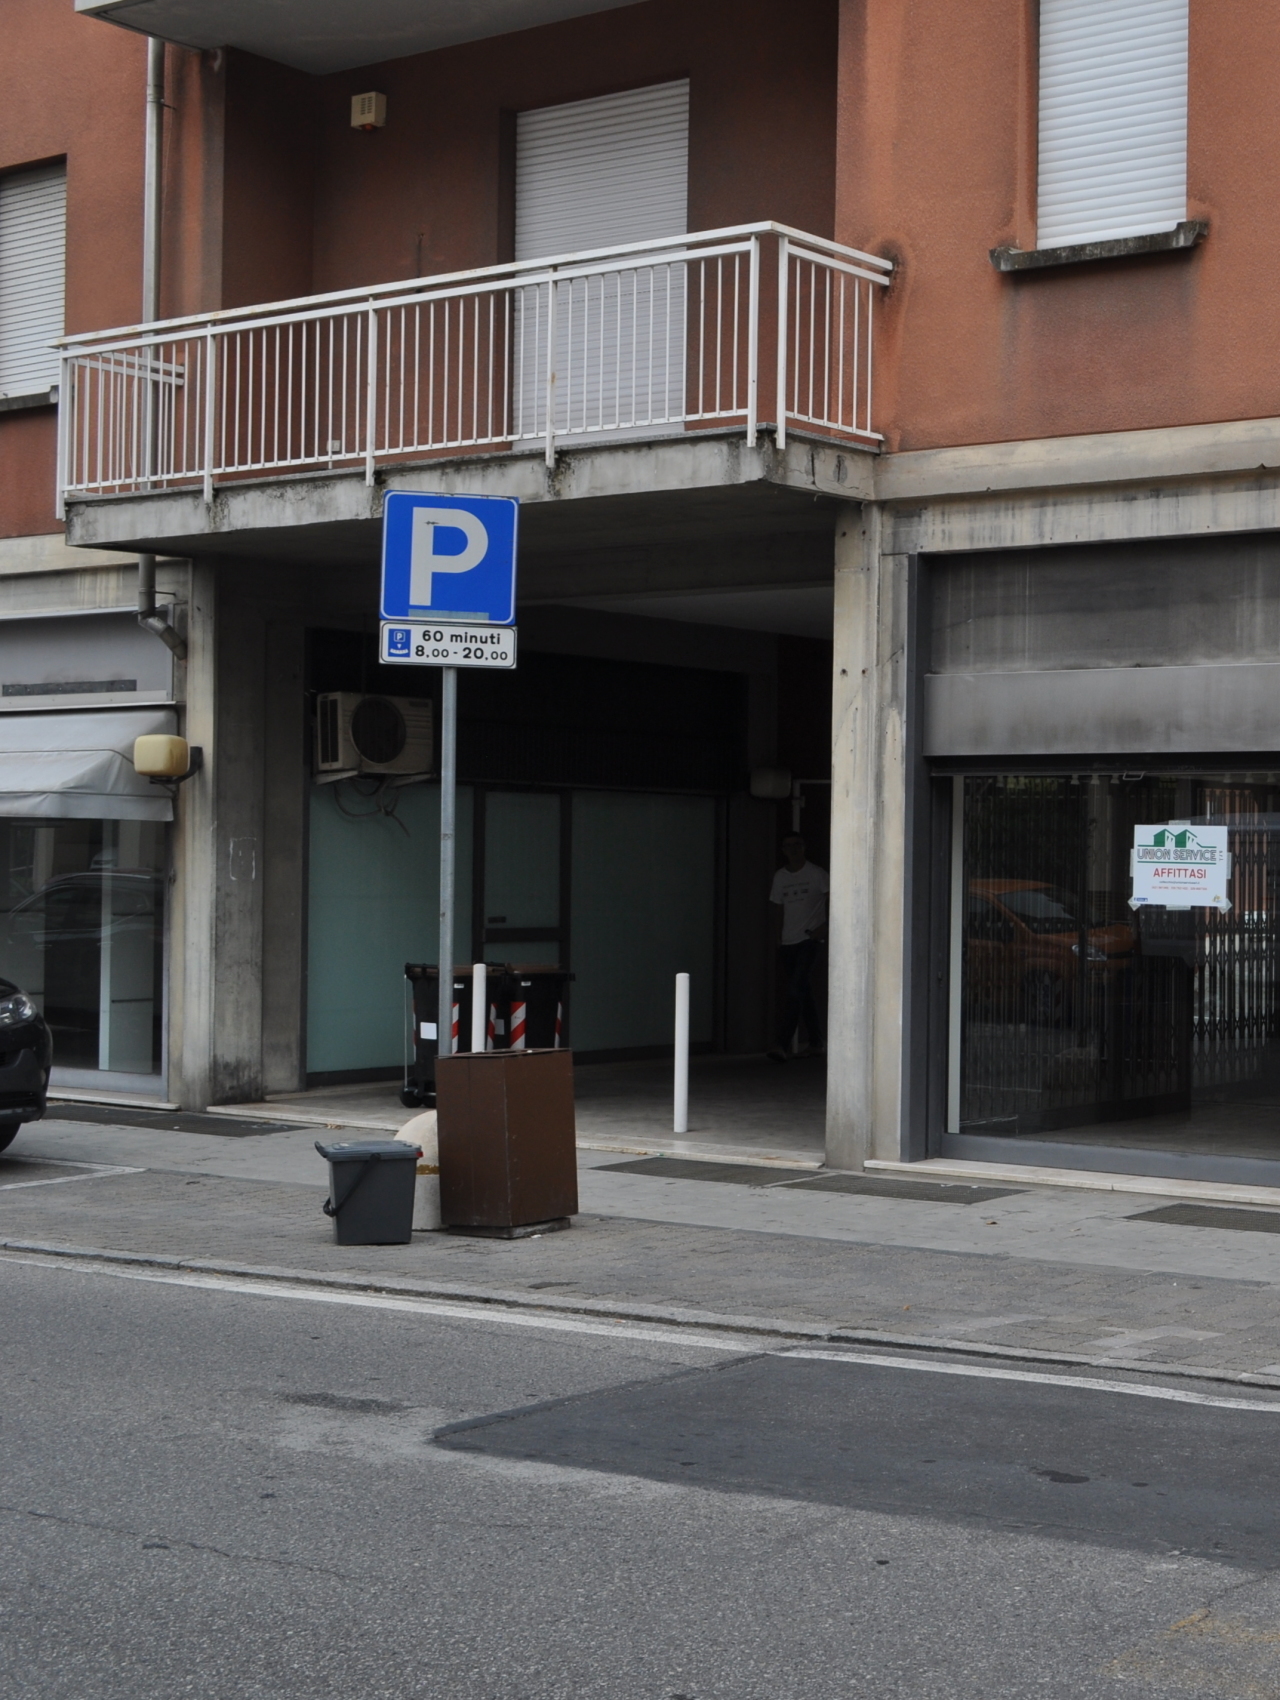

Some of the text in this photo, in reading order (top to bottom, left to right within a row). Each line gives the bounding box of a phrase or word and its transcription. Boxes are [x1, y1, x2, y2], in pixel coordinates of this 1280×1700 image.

[409, 506, 489, 606] P
[422, 630, 501, 645] 60 minuti
[1137, 848, 1217, 862] UNION SERVICE
[1153, 868, 1206, 878] AFFITTASI
